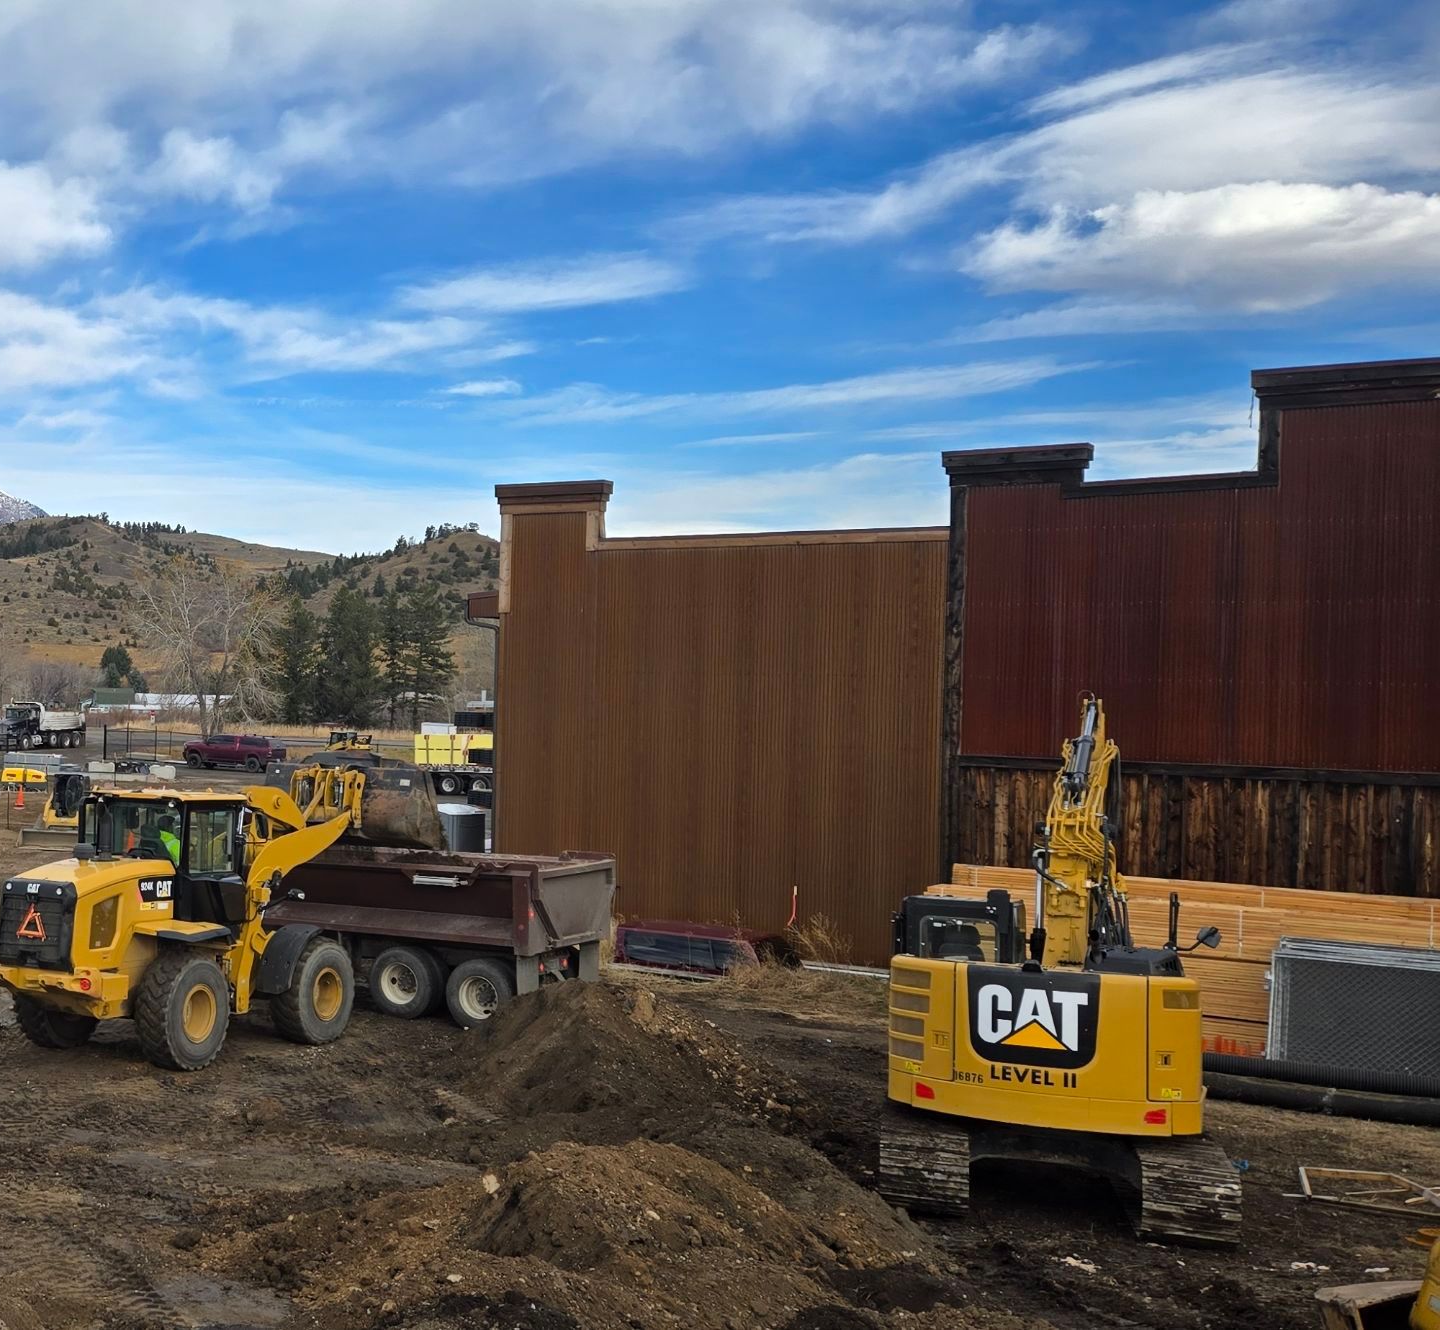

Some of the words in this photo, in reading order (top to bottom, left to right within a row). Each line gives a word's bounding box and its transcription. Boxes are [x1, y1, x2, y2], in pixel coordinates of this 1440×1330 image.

[27, 883, 40, 893] CAT
[156, 880, 173, 898] CAT
[977, 984, 1089, 1052] CAT
[990, 1064, 1055, 1087] LEVEL
[1063, 1072, 1077, 1089] II
